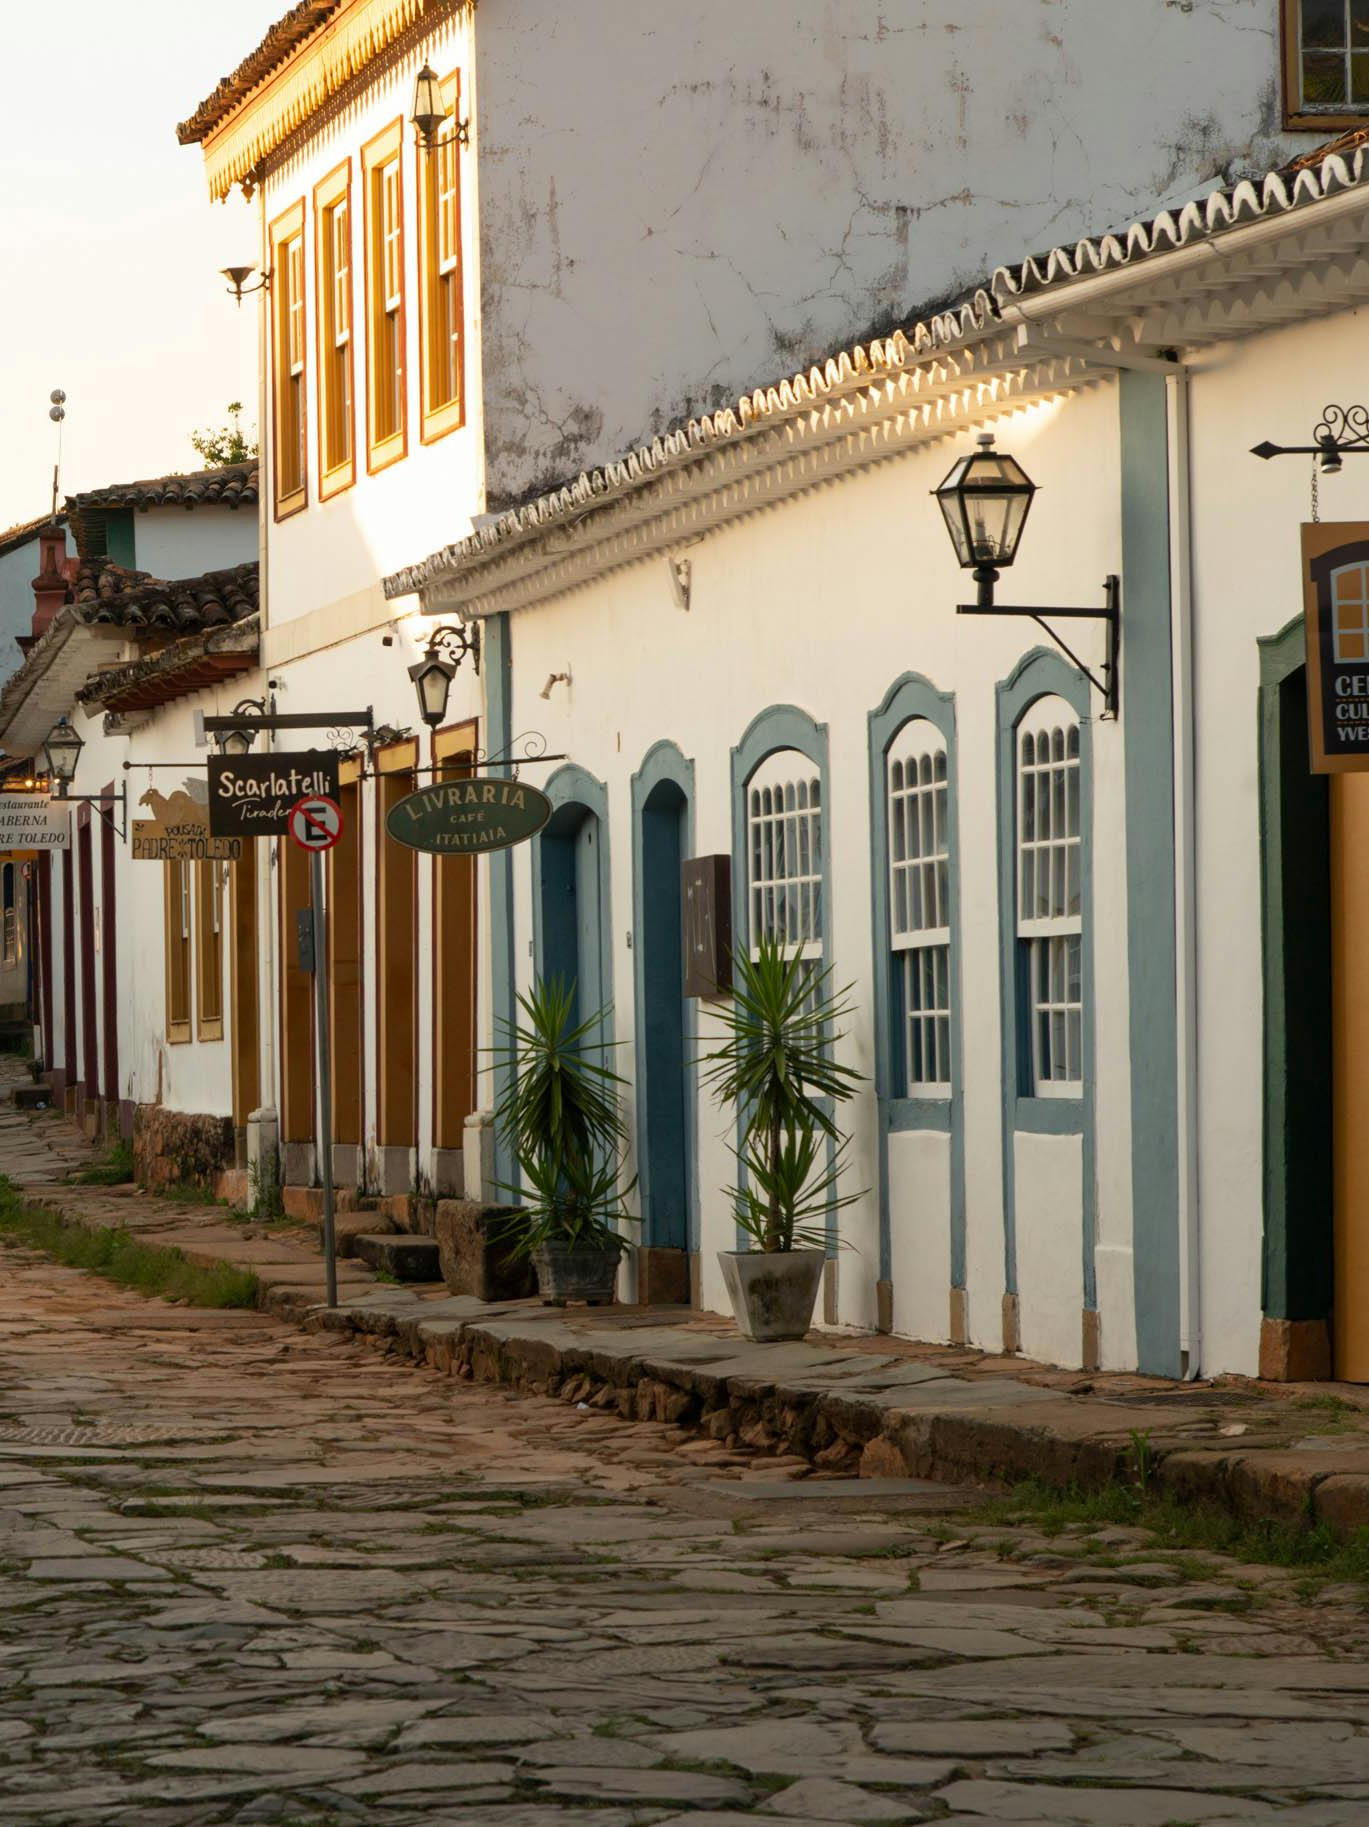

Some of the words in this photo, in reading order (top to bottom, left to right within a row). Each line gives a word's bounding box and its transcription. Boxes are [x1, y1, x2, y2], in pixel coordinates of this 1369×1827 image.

[1335, 675, 1369, 697] CE
[1337, 726, 1369, 741] YVE
[218, 769, 330, 798] Scarlatelli
[404, 785, 526, 821] LIVRARIA
[450, 809, 485, 823] CAFÉ
[18, 832, 65, 844] TOLEDO
[436, 827, 507, 846] ITATIAIA
[132, 837, 177, 859] PADRE
[187, 837, 241, 860] TOLEDO
